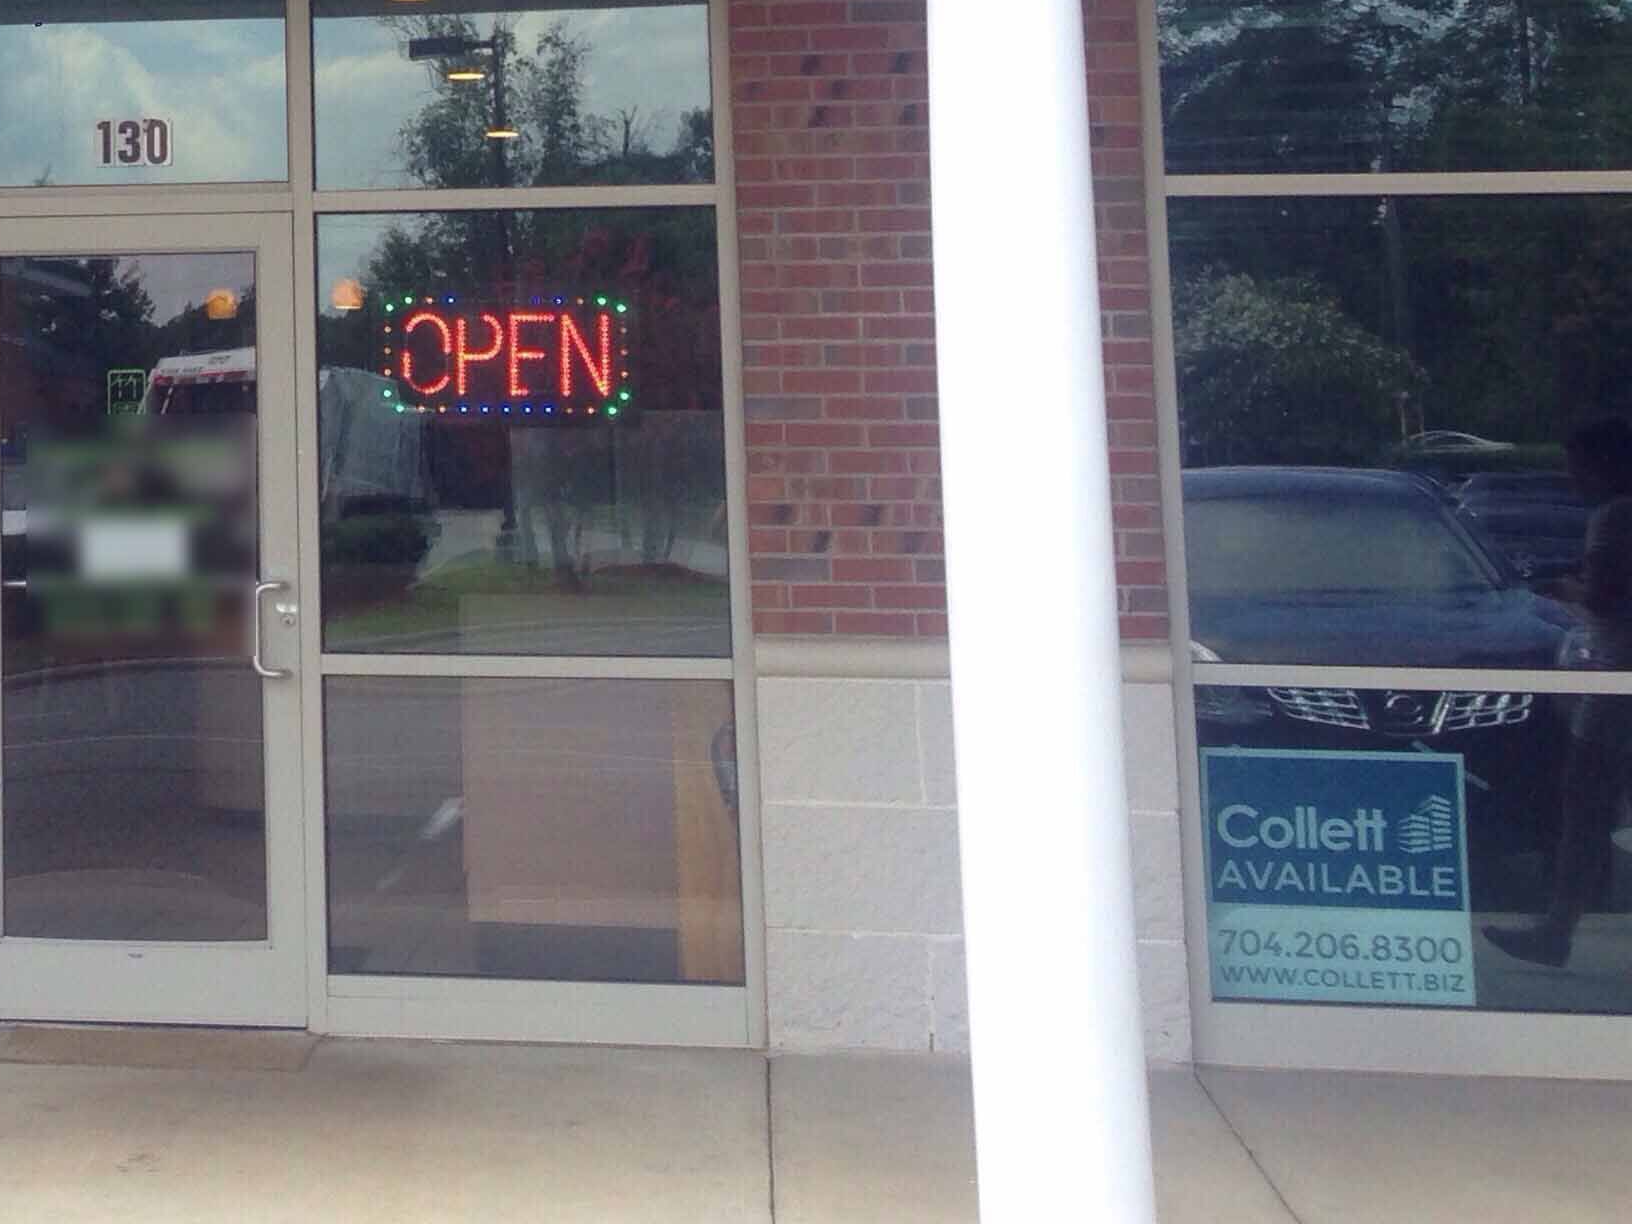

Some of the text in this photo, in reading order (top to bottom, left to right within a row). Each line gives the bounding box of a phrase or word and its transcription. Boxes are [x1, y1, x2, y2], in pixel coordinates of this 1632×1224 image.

[96, 119, 169, 165] 130
[401, 311, 612, 397] OPEN
[1217, 803, 1388, 852] Collett
[1218, 859, 1457, 897] AVAILABLE
[1219, 928, 1463, 964] 704.206.8300
[1220, 964, 1467, 993] WWW.COLLETT.BIZ
